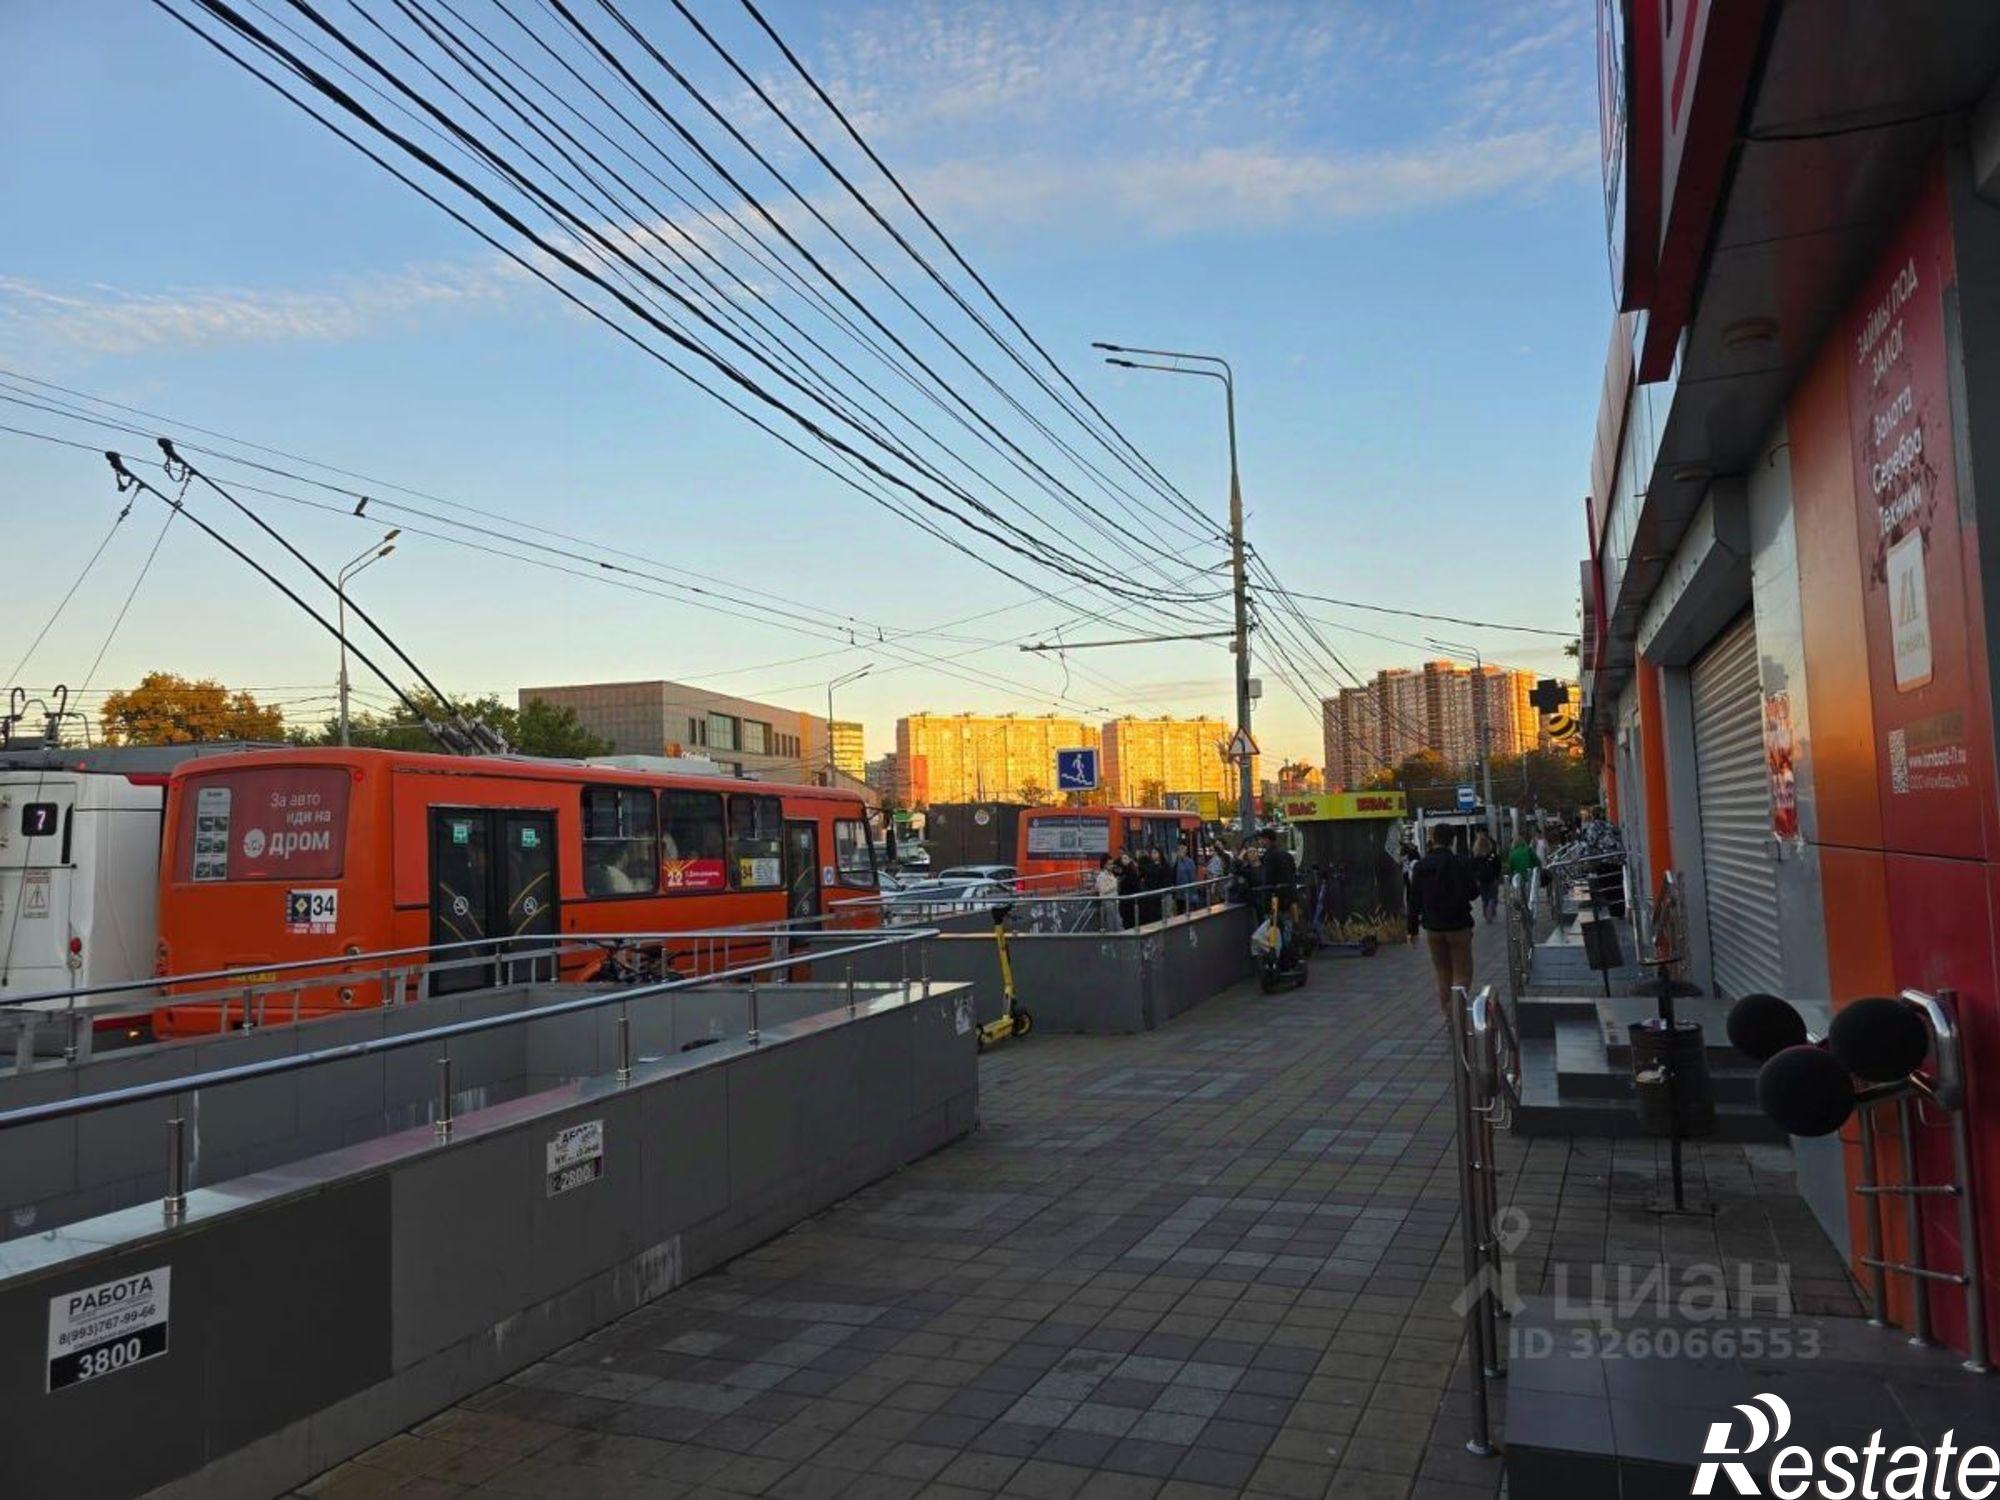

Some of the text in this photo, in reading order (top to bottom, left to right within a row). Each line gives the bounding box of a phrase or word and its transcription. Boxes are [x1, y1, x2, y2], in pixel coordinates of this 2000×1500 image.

[1891, 257, 1919, 314] ПОД
[1873, 319, 1903, 386] ЗАЛОГ
[1872, 426, 1923, 494] Серебра
[270, 792, 321, 807] За авто
[286, 810, 331, 825] иди на
[36, 810, 46, 830] 7
[268, 830, 330, 859] дром
[312, 894, 335, 916] 34
[69, 1276, 153, 1316] РАБОТА
[59, 1304, 156, 1346] 8(993)767-99-66
[78, 1338, 141, 1379] 3800
